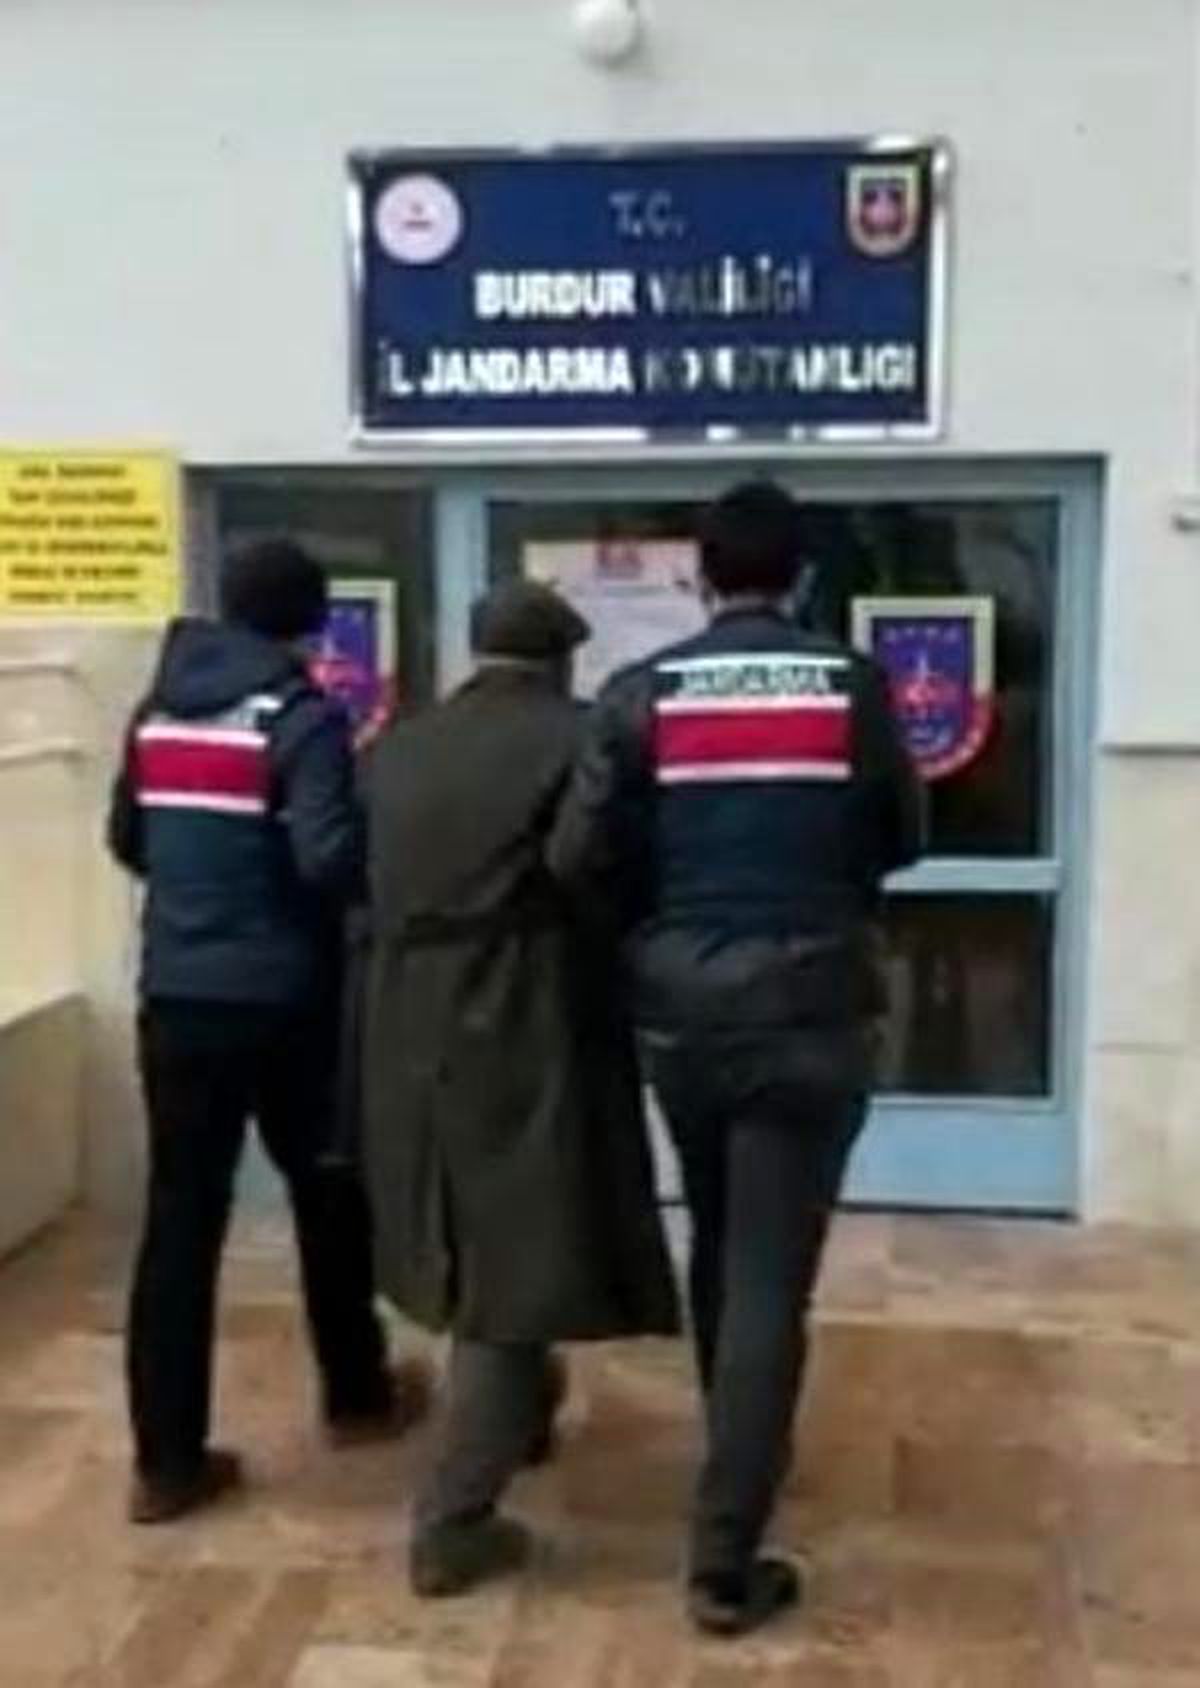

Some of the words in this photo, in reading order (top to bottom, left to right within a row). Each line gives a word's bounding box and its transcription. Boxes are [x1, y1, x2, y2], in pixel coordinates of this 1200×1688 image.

[608, 189, 686, 238] T.C.
[474, 270, 636, 319] BURDUR
[421, 348, 635, 394] JANDARMA
